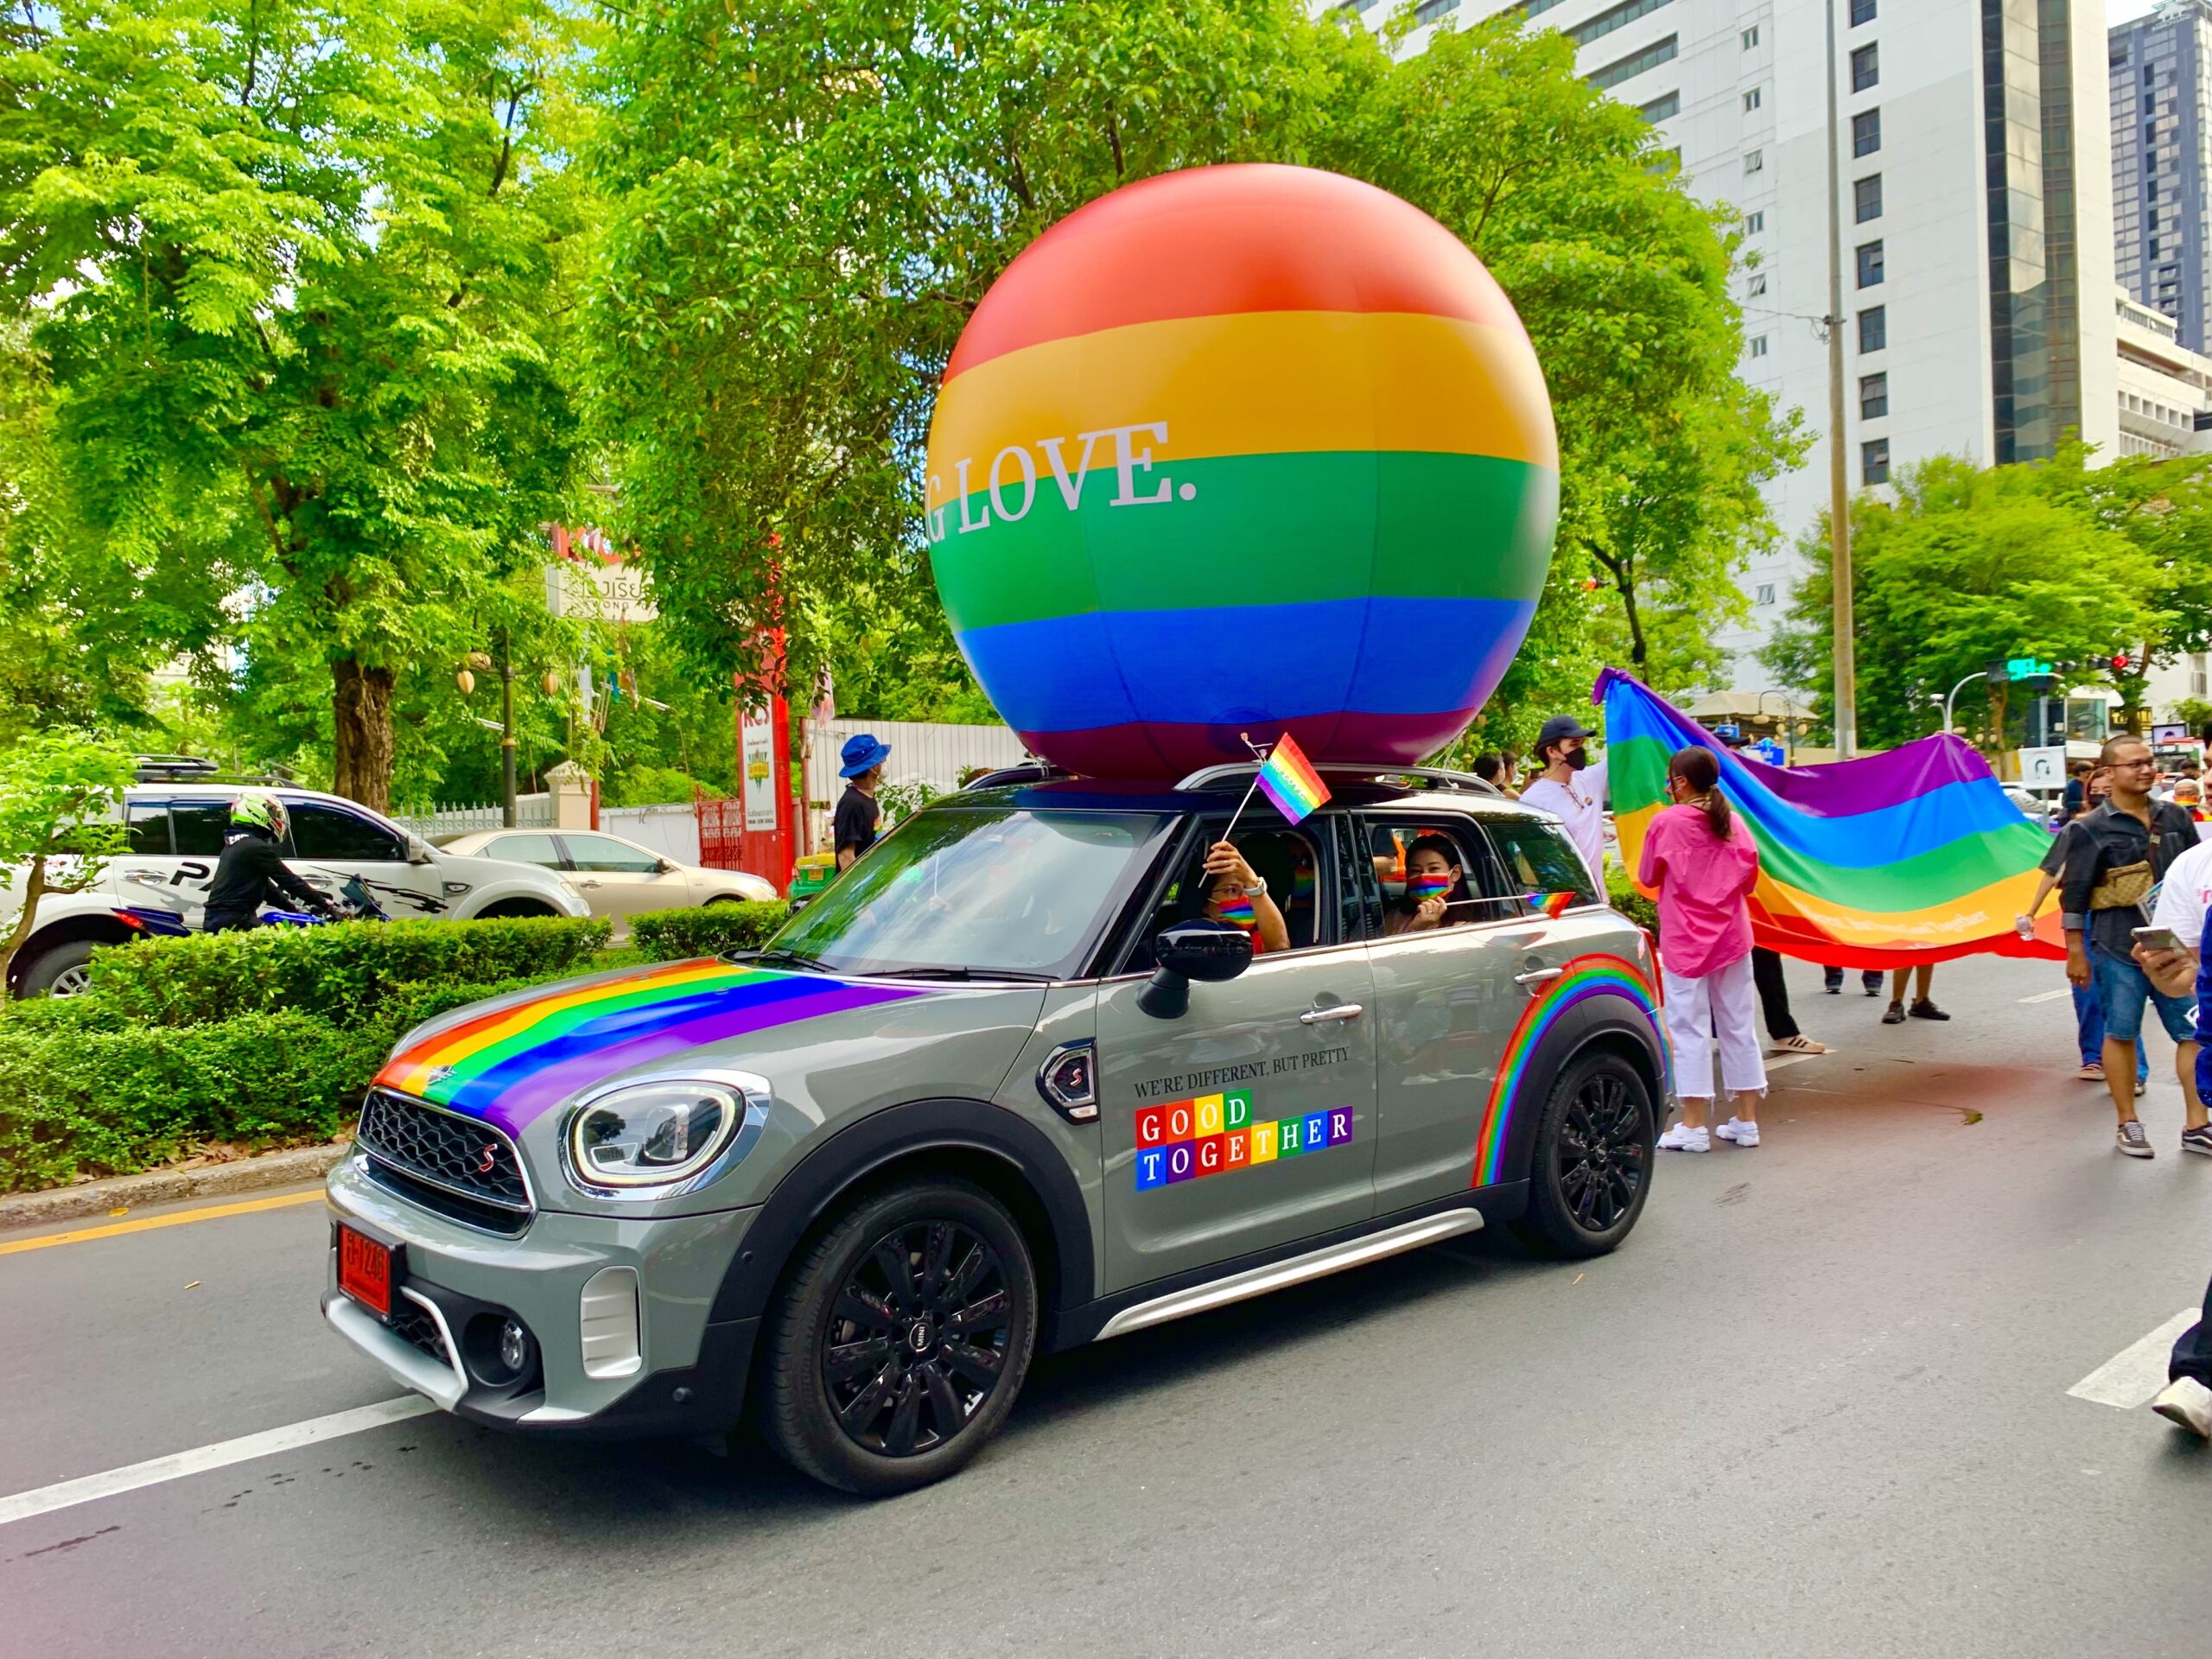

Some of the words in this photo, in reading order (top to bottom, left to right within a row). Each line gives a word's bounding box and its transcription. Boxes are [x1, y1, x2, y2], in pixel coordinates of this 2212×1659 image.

[955, 421, 1197, 534] LOVE.
[1071, 1068, 1083, 1086] S
[1134, 1076, 1183, 1098] WE'RE
[1187, 1061, 1269, 1090] DIFFERENT,
[1273, 1055, 1299, 1074] BUT
[1302, 1046, 1350, 1069] PRETTY
[1141, 1098, 1246, 1142] GOOD
[478, 1143, 498, 1173] S
[1143, 1114, 1348, 1181] TOGETHER
[917, 1325, 925, 1346] MINI
